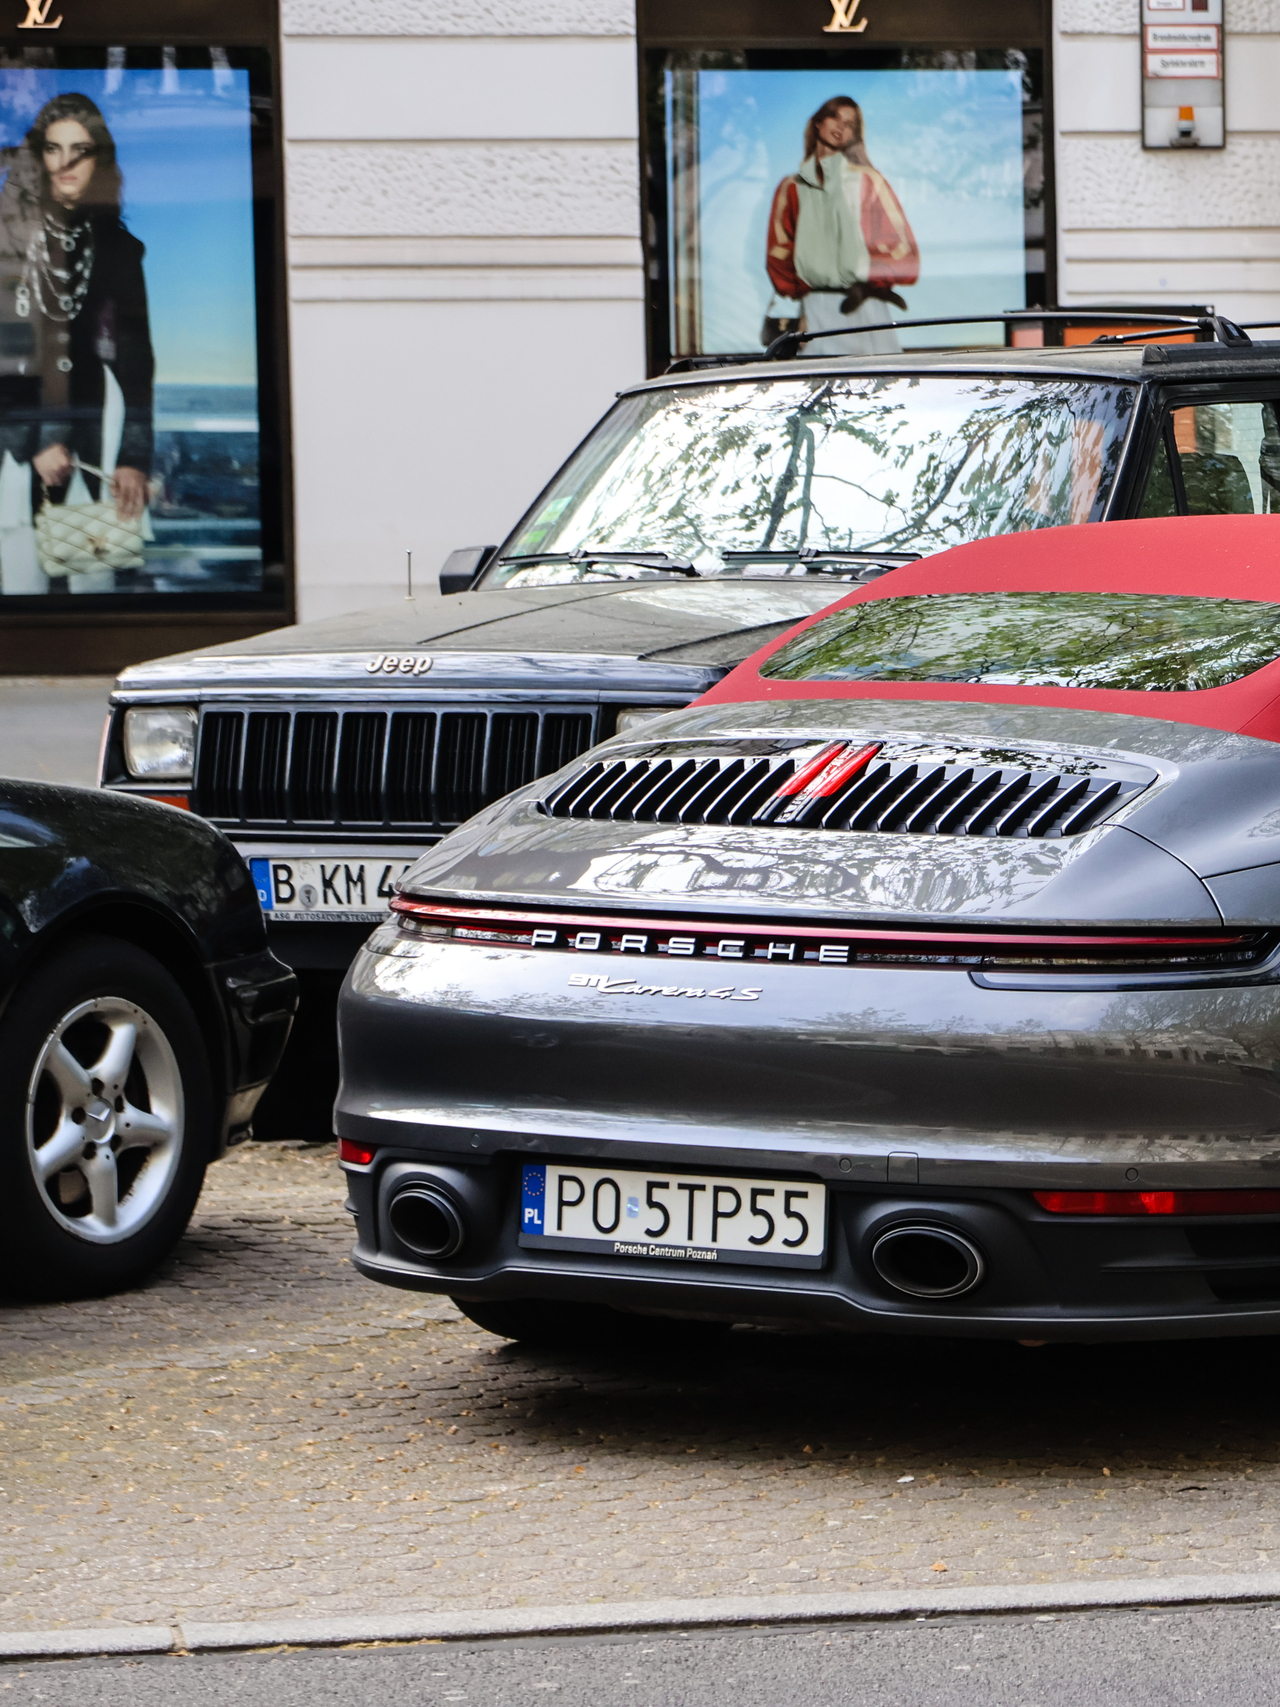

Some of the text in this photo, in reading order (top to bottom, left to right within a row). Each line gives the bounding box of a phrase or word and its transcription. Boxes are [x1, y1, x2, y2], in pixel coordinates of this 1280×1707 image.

[365, 654, 433, 677] Jeep
[272, 863, 412, 905] B KM 4
[294, 912, 342, 921] AUTOSALON
[531, 929, 850, 963] PORSCHE
[597, 979, 706, 998] Carrera
[524, 1208, 542, 1225] PL
[557, 1174, 809, 1248] PO 5TP55
[614, 1242, 718, 1260] Porsche Centrum Poznań
